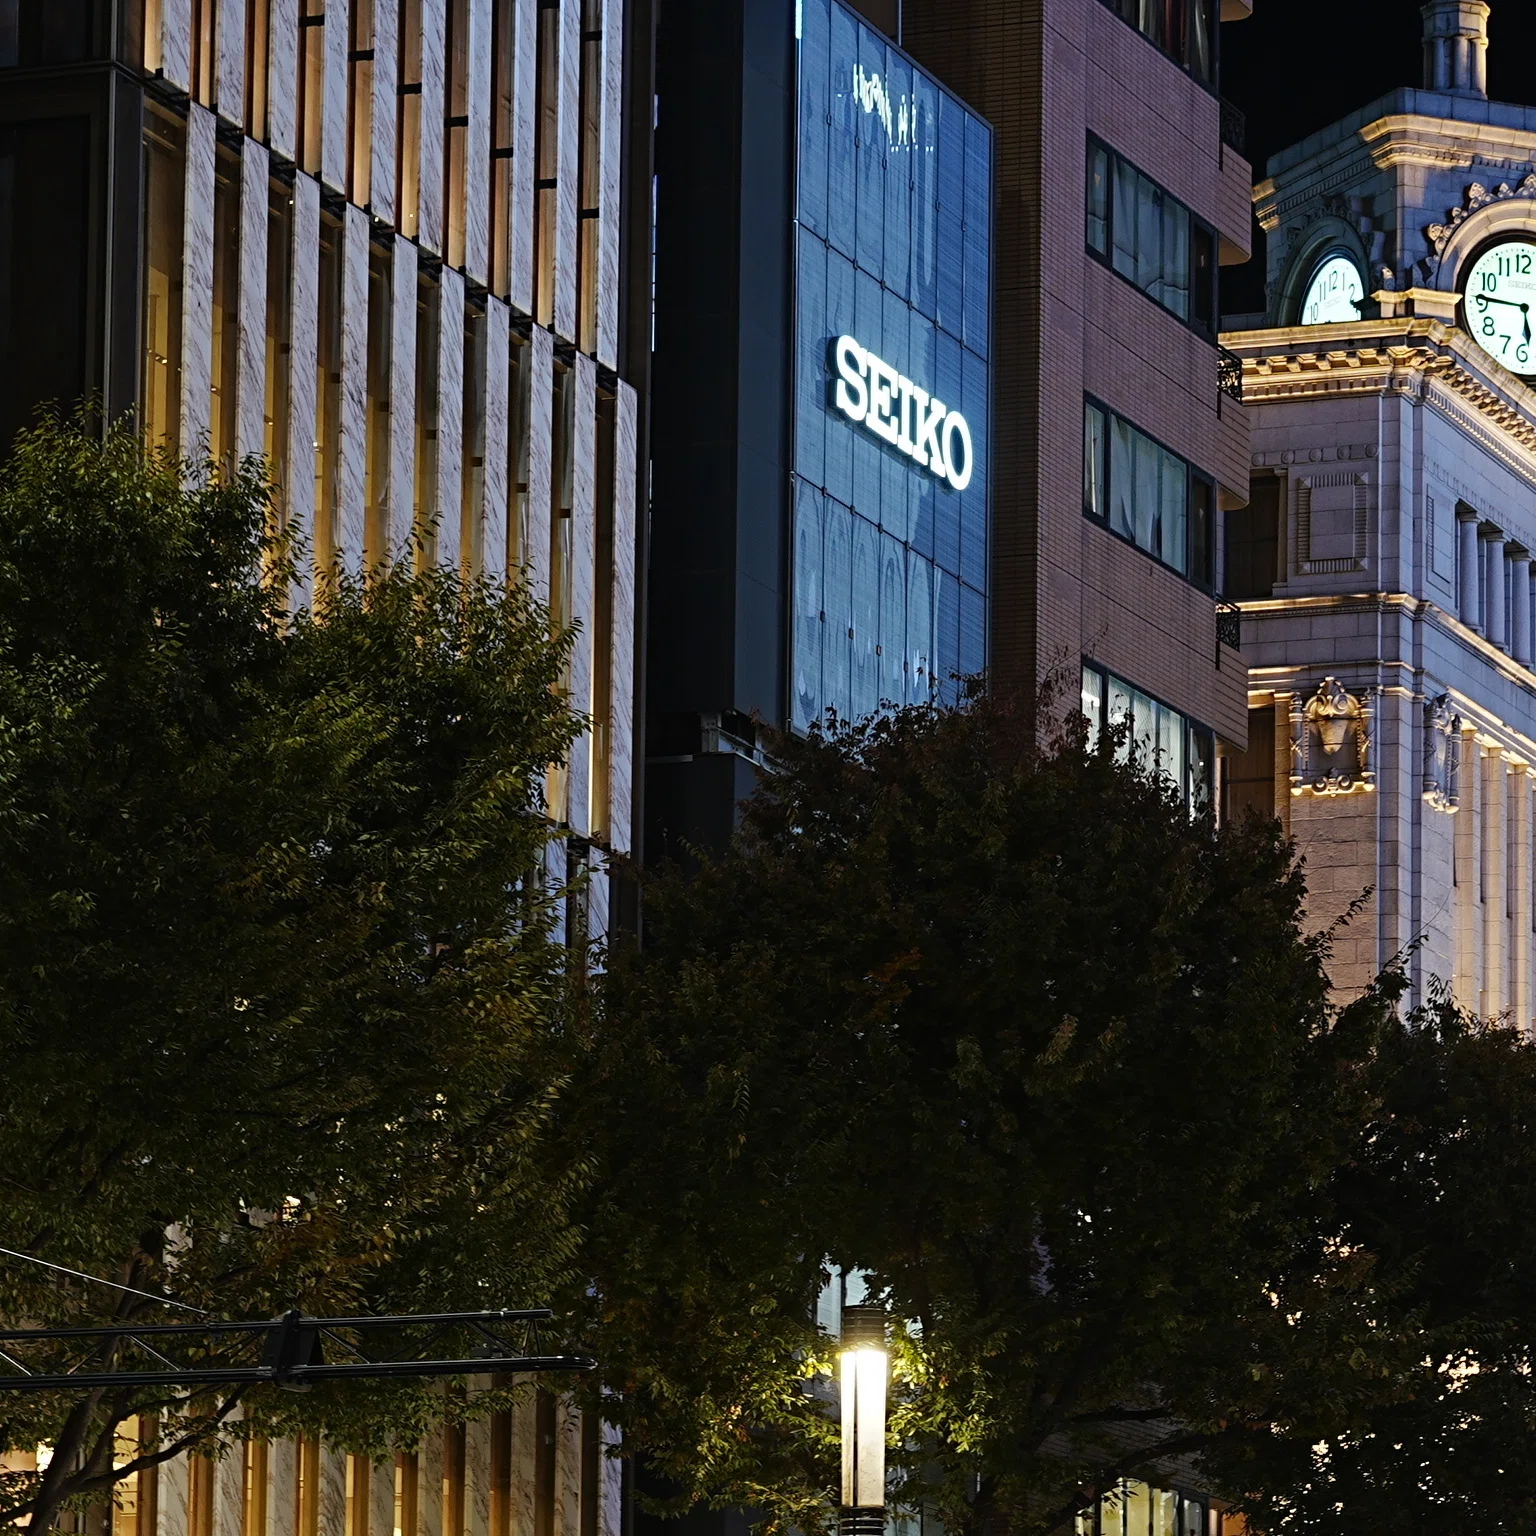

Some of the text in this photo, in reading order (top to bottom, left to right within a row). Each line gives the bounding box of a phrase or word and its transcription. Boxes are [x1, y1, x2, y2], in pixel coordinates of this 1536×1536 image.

[1497, 257, 1510, 277] 11
[1515, 255, 1531, 274] 12
[1482, 272, 1497, 292] 10
[1483, 317, 1495, 336] 8
[1499, 335, 1511, 354] 7
[1515, 344, 1528, 362] 6
[836, 334, 974, 491] SEIKO
